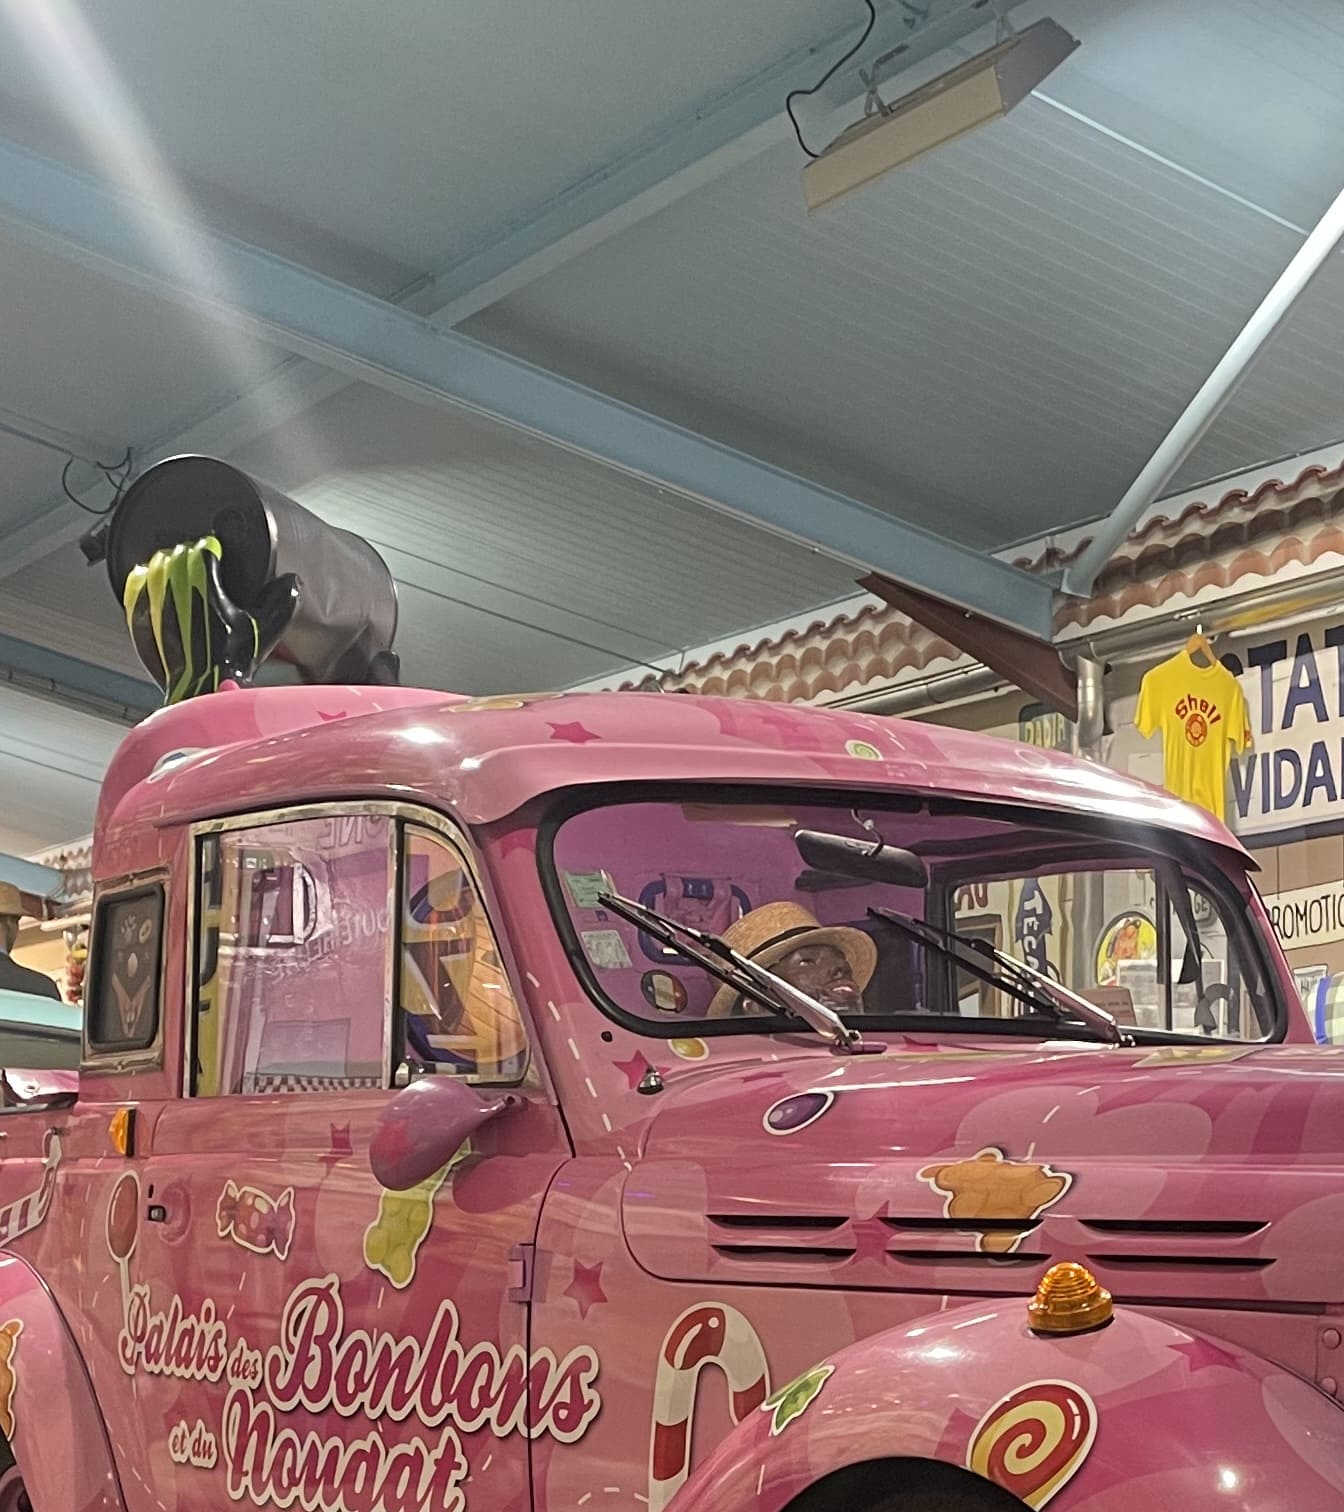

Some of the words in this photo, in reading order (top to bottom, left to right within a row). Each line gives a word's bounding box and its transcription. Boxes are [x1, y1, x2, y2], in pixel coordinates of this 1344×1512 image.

[1175, 693, 1221, 725] Shell
[119, 1286, 227, 1377] Palais
[229, 1339, 261, 1383] des
[269, 1278, 599, 1438] Bonbons
[170, 1431, 189, 1460] et
[190, 1423, 215, 1463] du
